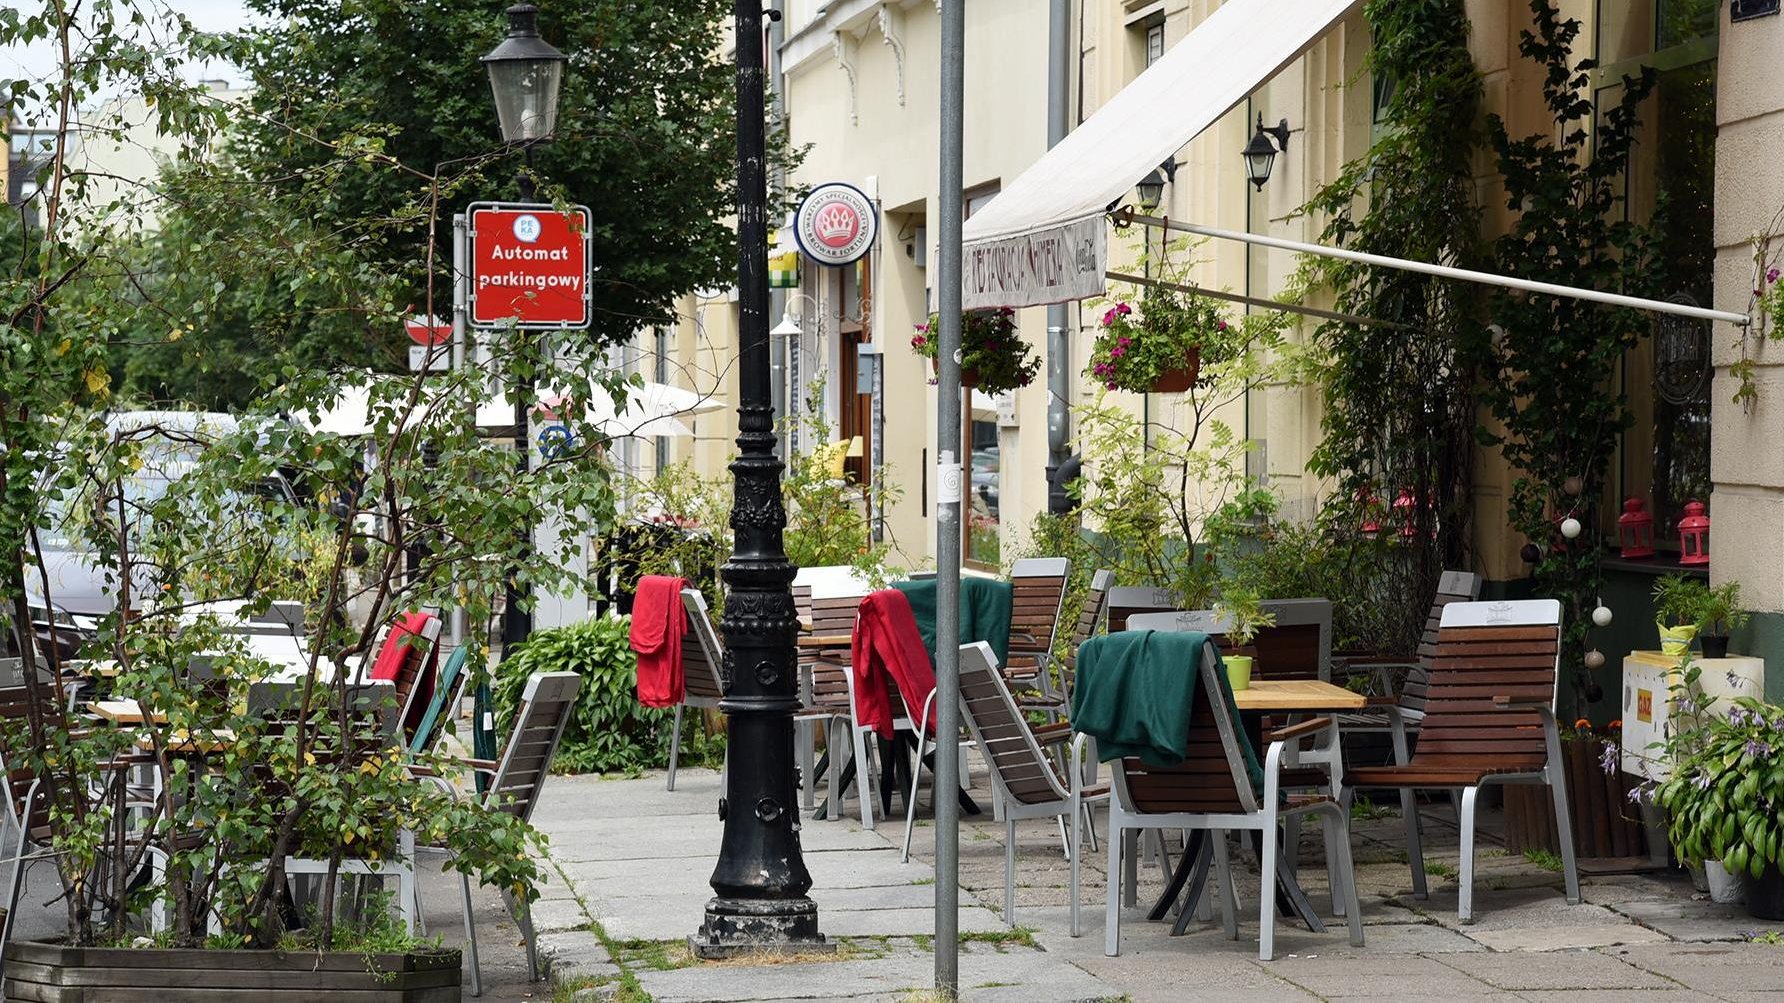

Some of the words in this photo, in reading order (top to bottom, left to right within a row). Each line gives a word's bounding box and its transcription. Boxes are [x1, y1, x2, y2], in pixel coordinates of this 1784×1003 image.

[807, 232, 837, 256] BROWAR
[840, 225, 868, 256] FORTUNA
[491, 244, 568, 260] Automat
[479, 271, 580, 291] parkingowy
[1638, 695, 1652, 716] GAZ
